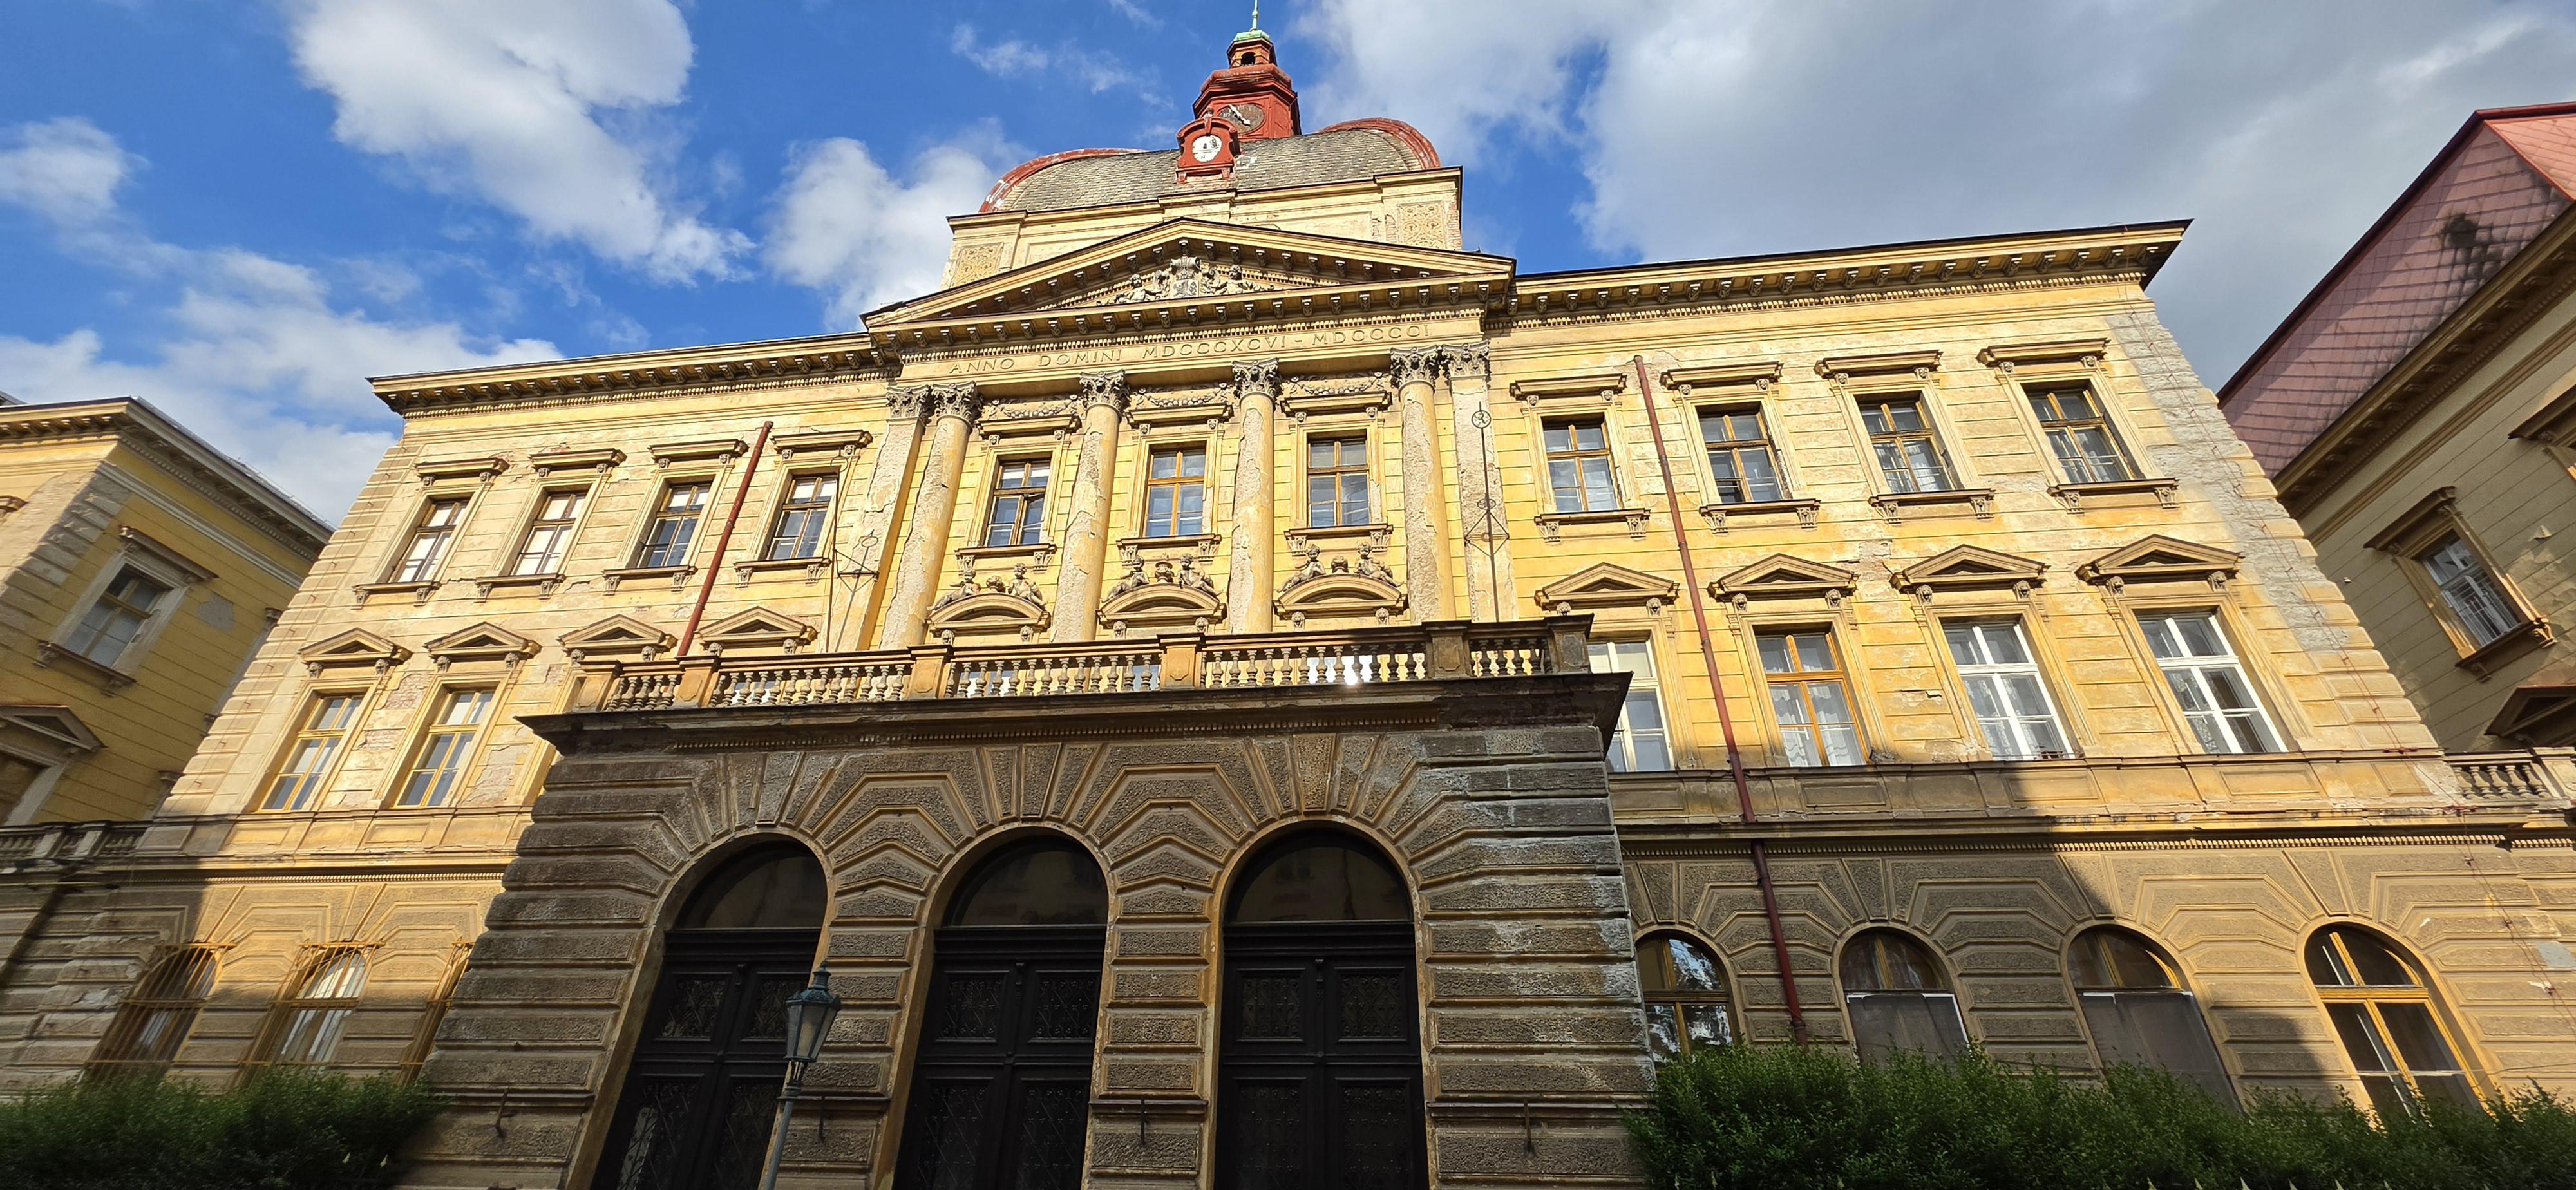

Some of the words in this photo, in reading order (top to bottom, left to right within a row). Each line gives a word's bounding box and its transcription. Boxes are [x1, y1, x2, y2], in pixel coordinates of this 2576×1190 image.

[949, 357, 1015, 374] ANNO
[1037, 348, 1122, 368] DOMINI
[1142, 335, 1286, 359] MDCCCXCVI
[1312, 324, 1428, 346] MDCCCCI
